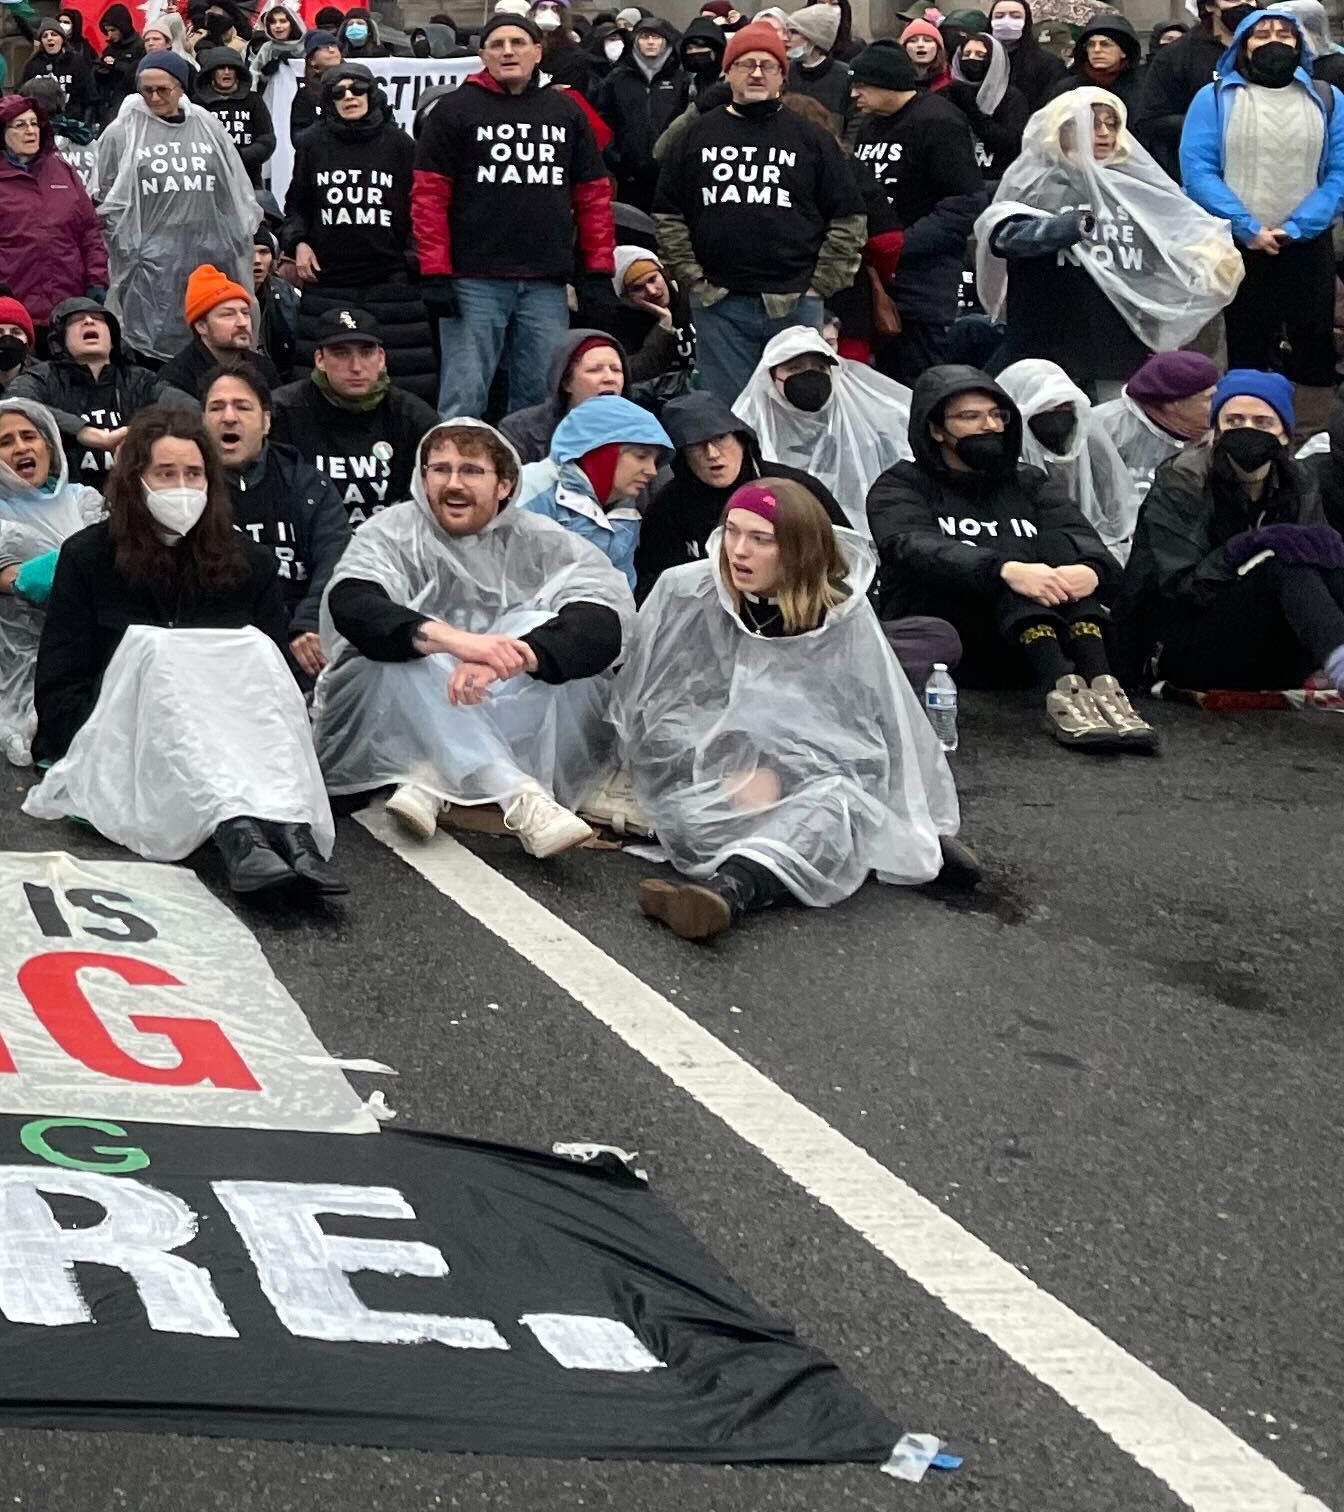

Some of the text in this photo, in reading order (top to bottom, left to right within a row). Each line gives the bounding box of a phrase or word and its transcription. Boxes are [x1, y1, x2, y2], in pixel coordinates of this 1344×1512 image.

[235, 110, 251, 121] IN
[477, 123, 566, 144] NOT IN
[137, 142, 213, 161] NOT IN
[491, 142, 555, 163] OUR
[702, 146, 796, 167] NOT IN
[151, 155, 207, 174] OUR
[712, 164, 780, 184] OUR
[141, 175, 216, 195] NAME
[317, 169, 393, 188] NOT IN
[477, 165, 564, 186] NAME
[326, 187, 383, 205] OUR
[701, 184, 793, 208] NAME
[321, 207, 392, 228] NAME
[938, 517, 1038, 538] NOT IN
[23, 881, 159, 944] IS
